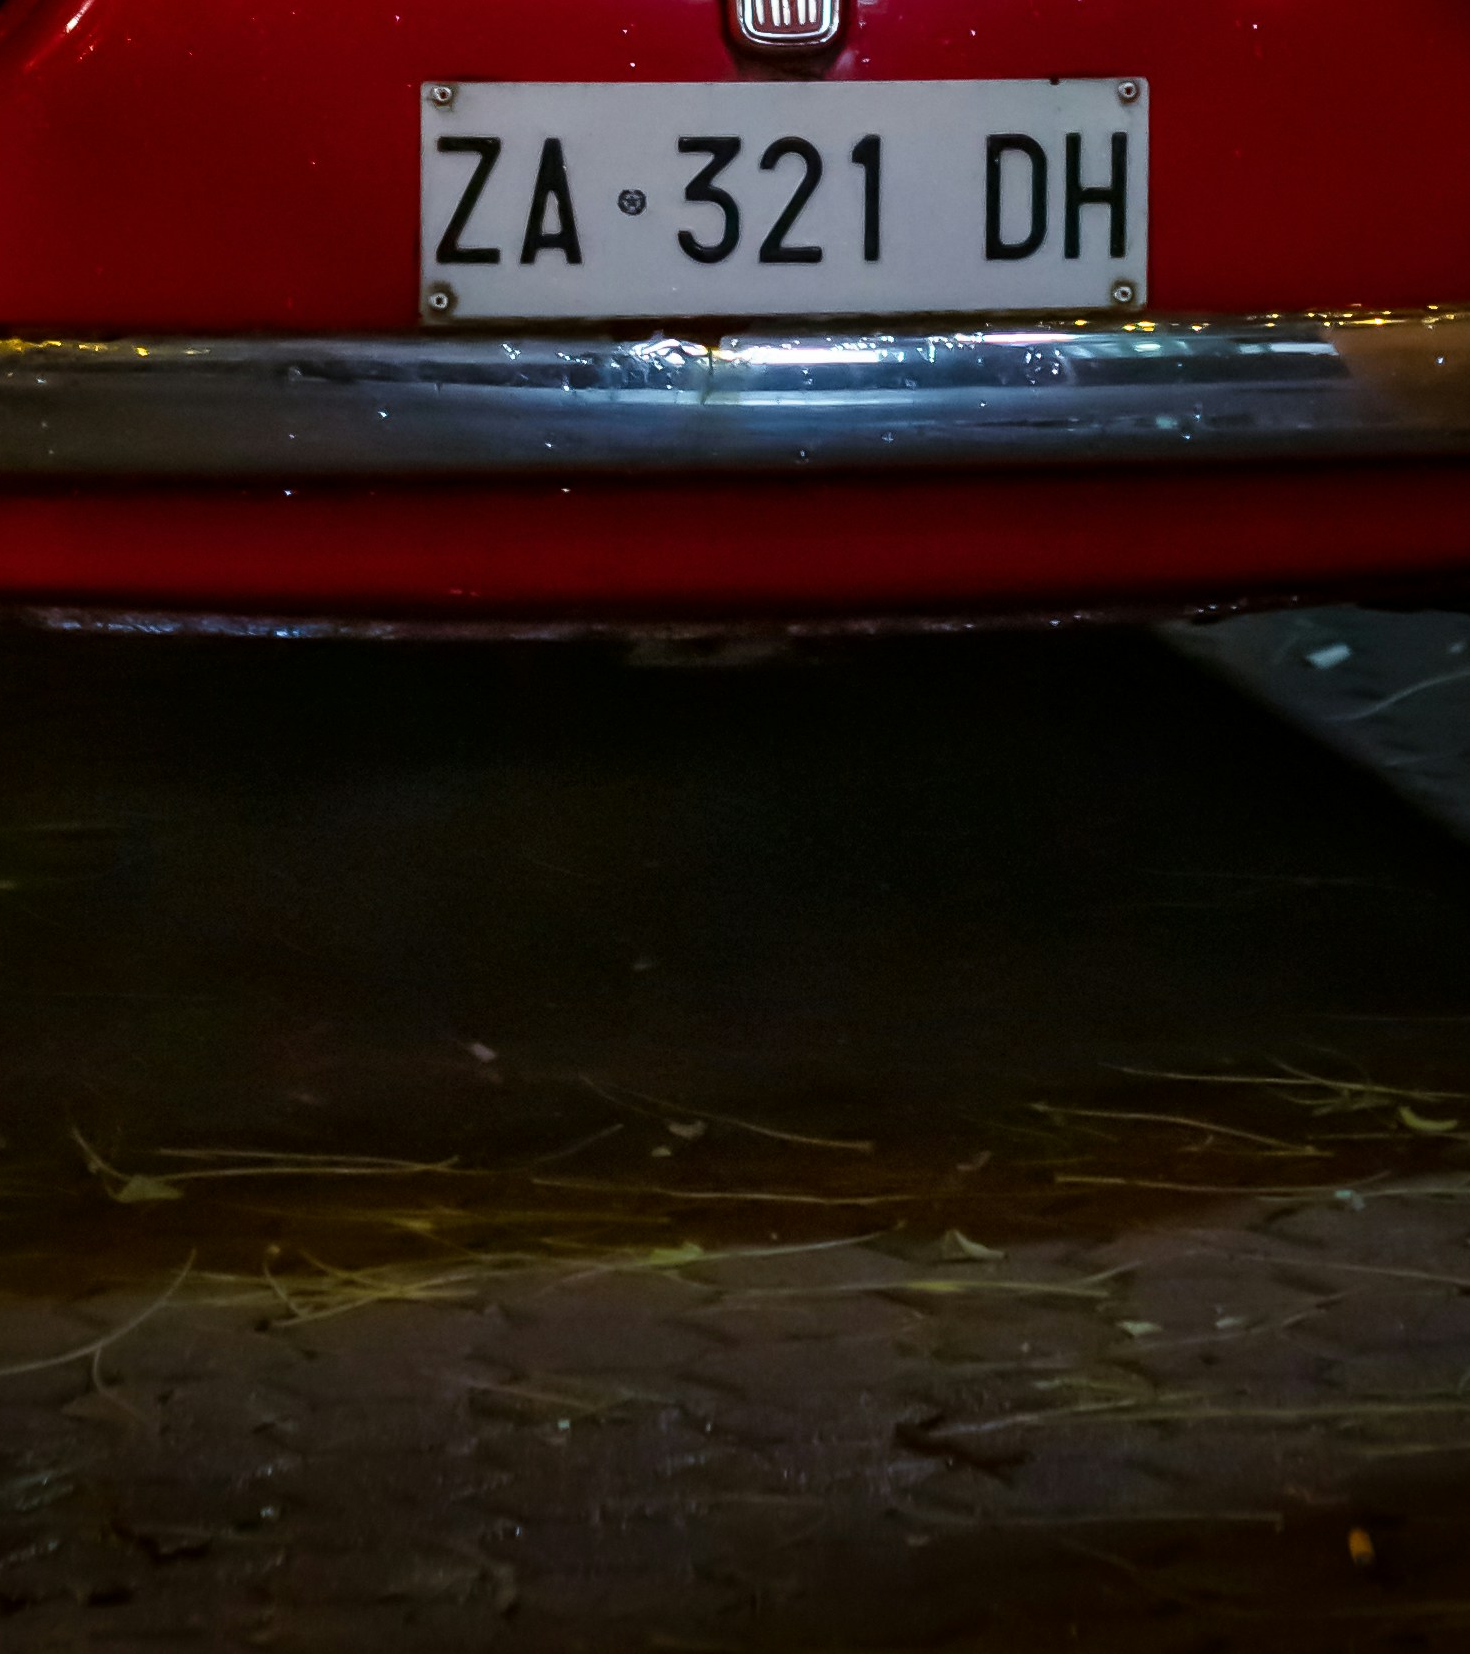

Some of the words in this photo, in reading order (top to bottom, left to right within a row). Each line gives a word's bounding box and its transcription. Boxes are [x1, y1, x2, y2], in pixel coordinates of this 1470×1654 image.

[436, 136, 582, 265] ZA
[677, 134, 882, 264] 321
[985, 131, 1128, 261] DH
